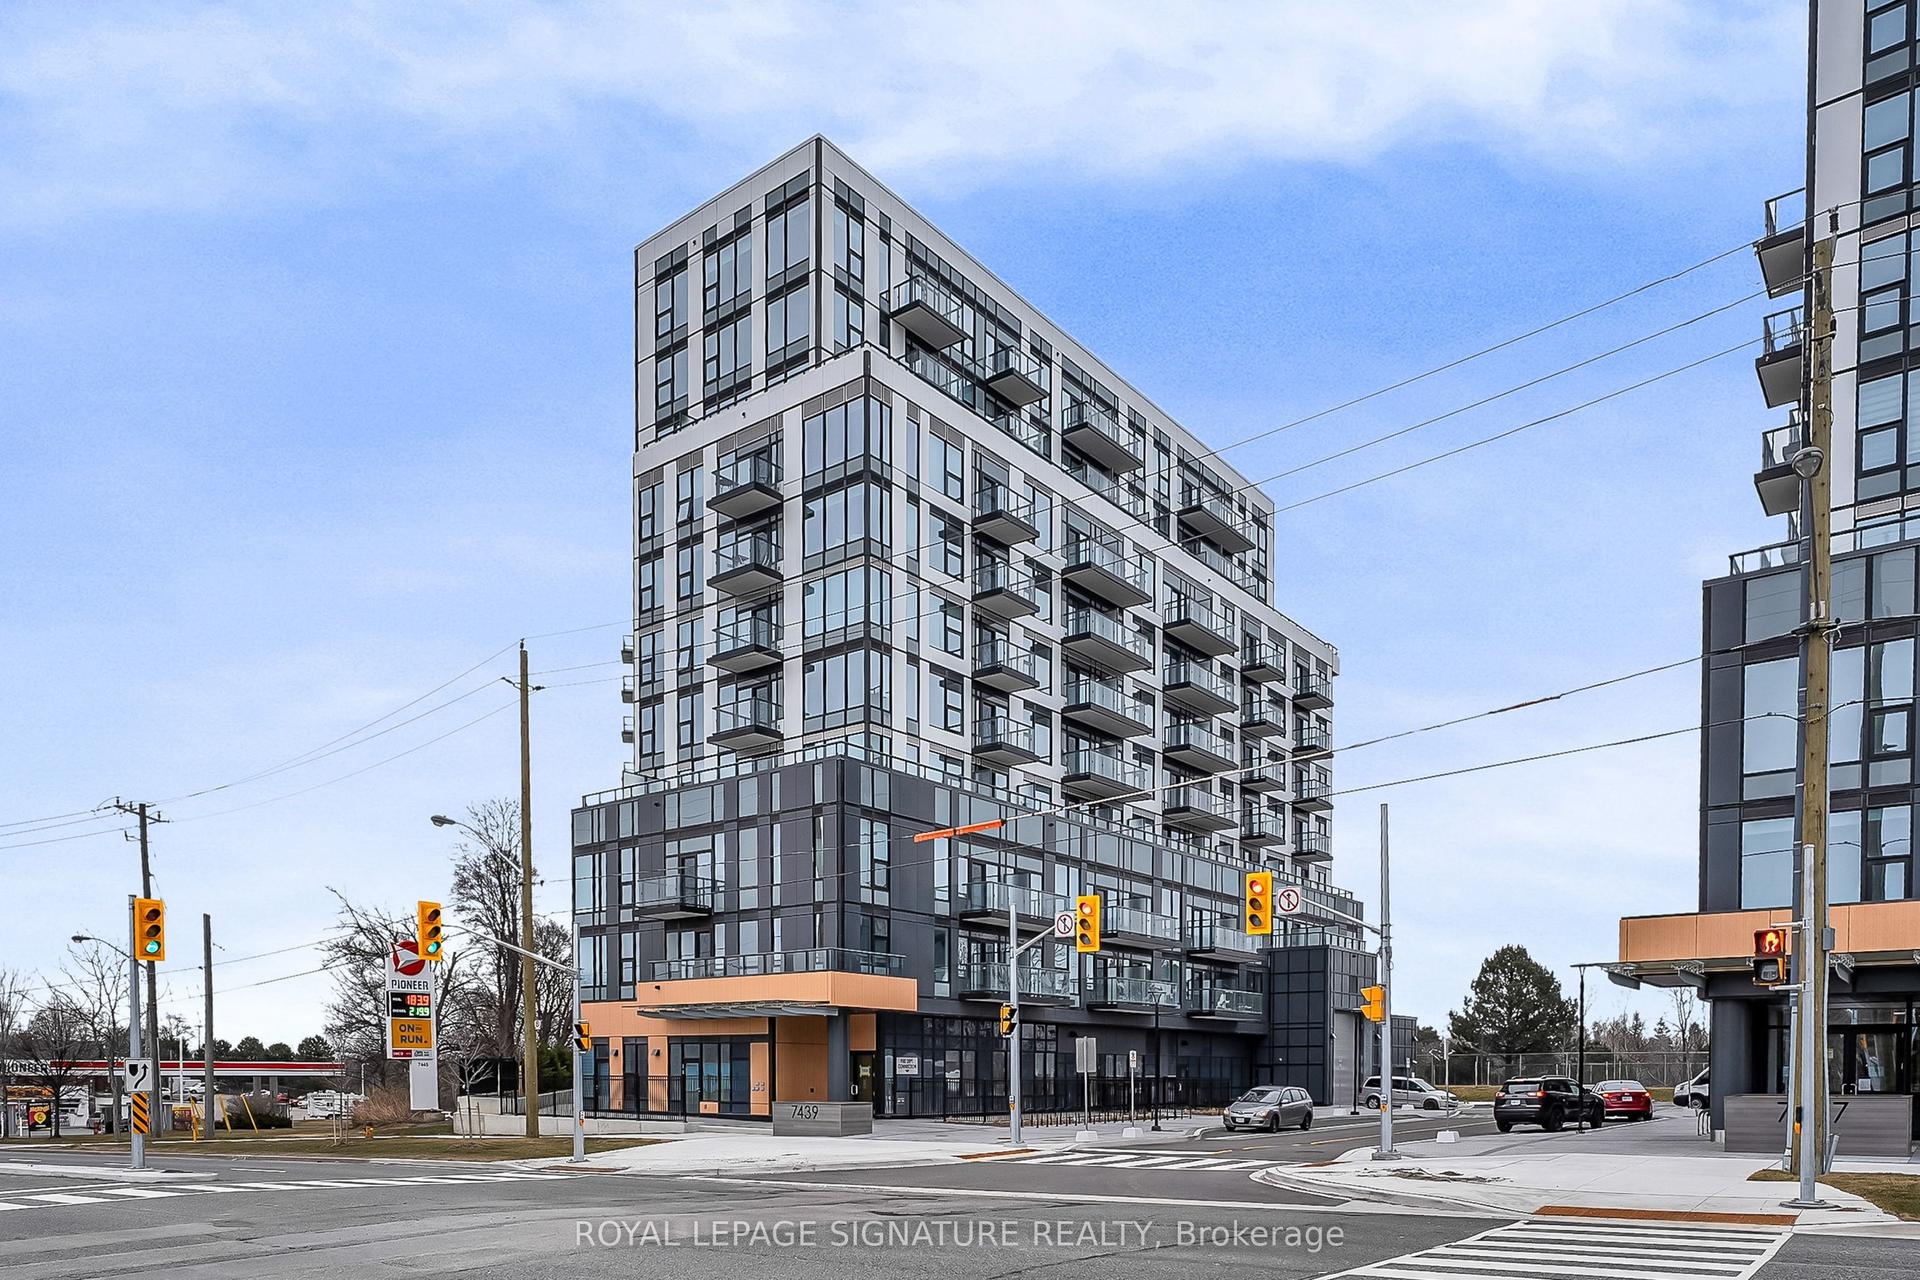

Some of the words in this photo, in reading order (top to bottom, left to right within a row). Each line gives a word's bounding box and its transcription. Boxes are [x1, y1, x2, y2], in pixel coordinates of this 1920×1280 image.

[391, 979, 429, 990] PIONEER
[399, 1024, 415, 1033] ON
[791, 1105, 819, 1120] 7439
[1777, 1101, 1850, 1124] 77
